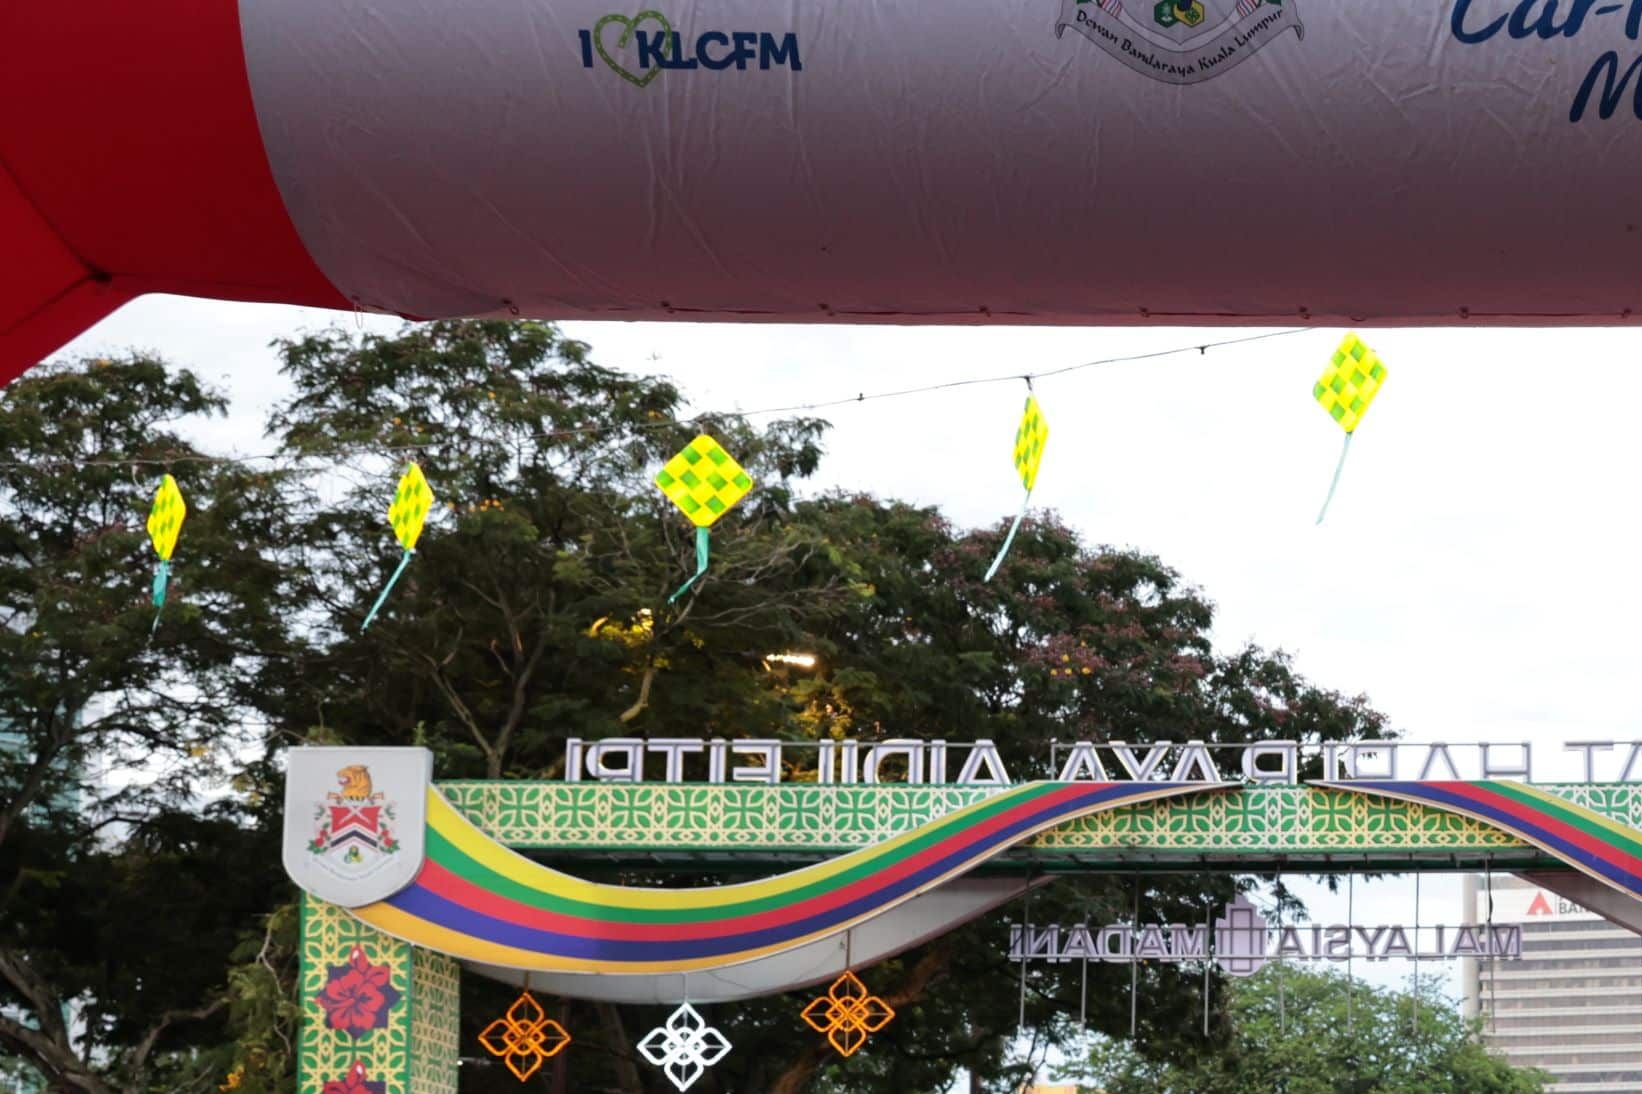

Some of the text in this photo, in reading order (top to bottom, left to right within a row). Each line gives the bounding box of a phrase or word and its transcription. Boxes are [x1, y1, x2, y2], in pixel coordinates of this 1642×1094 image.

[577, 30, 803, 71] I KLCFM
[1075, 8, 1284, 78] Dewan Bandaraya Kuala Lumpur
